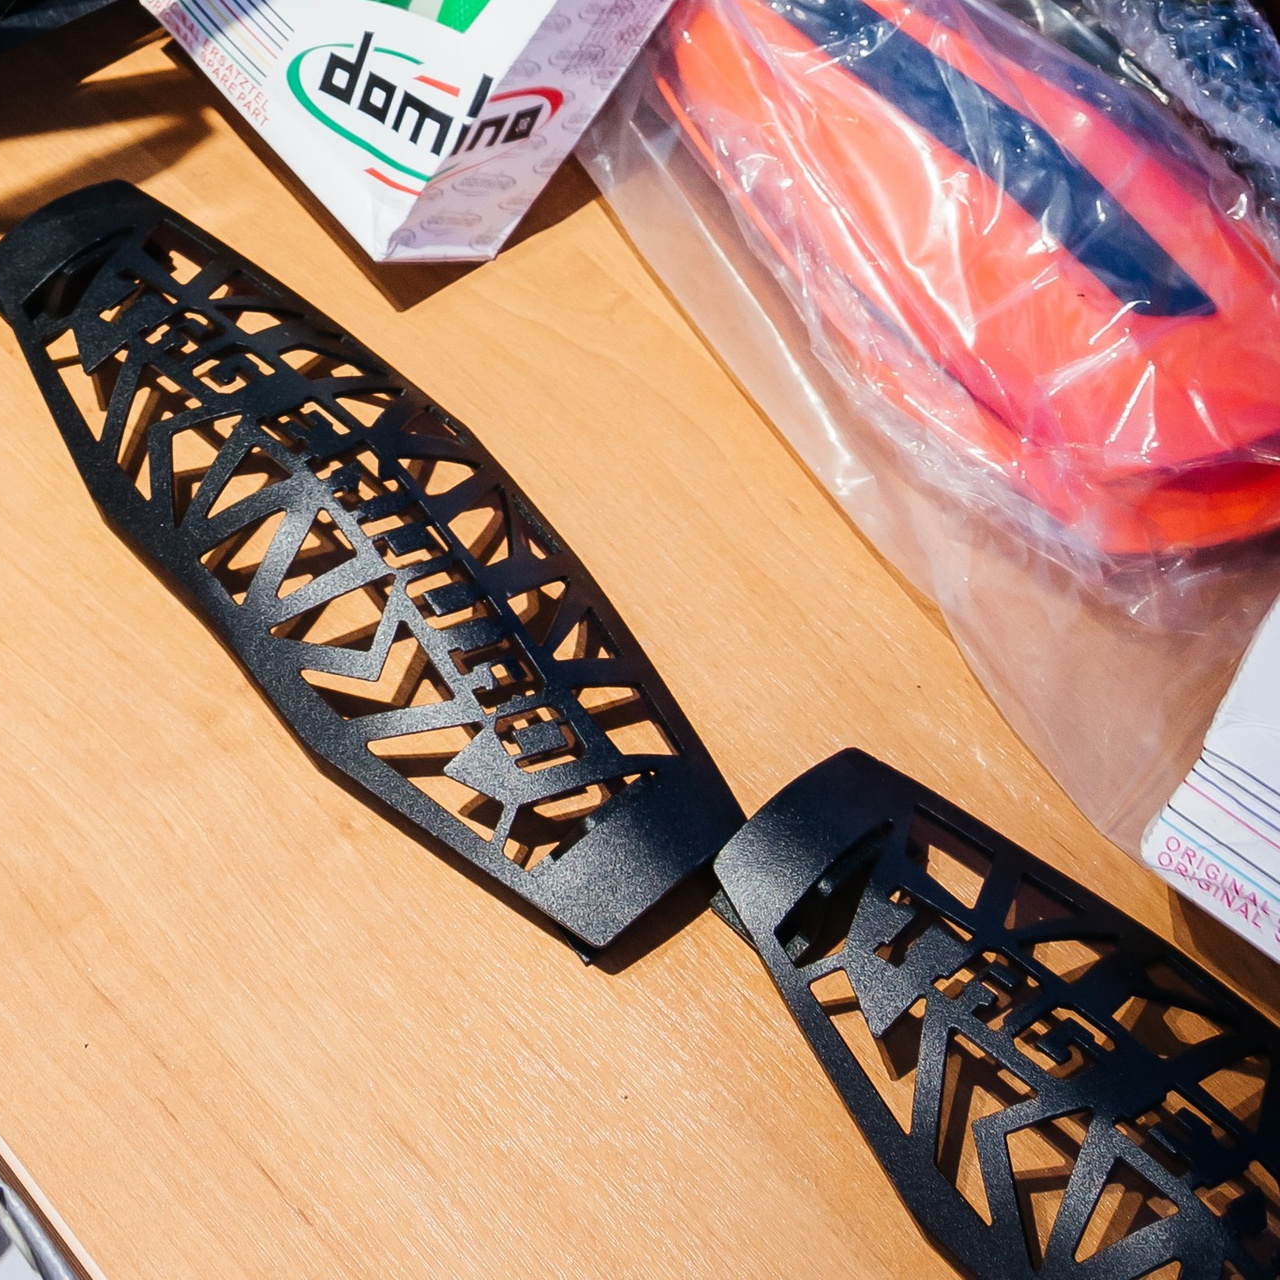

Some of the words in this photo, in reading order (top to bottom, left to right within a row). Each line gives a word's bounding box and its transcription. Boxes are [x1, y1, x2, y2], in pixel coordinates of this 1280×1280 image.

[200, 50, 238, 96] SPARE
[236, 91, 270, 126] PART
[318, 30, 545, 158] domino
[1157, 850, 1262, 931] ORIGINAL
[1165, 835, 1271, 918] ORIGINAL
